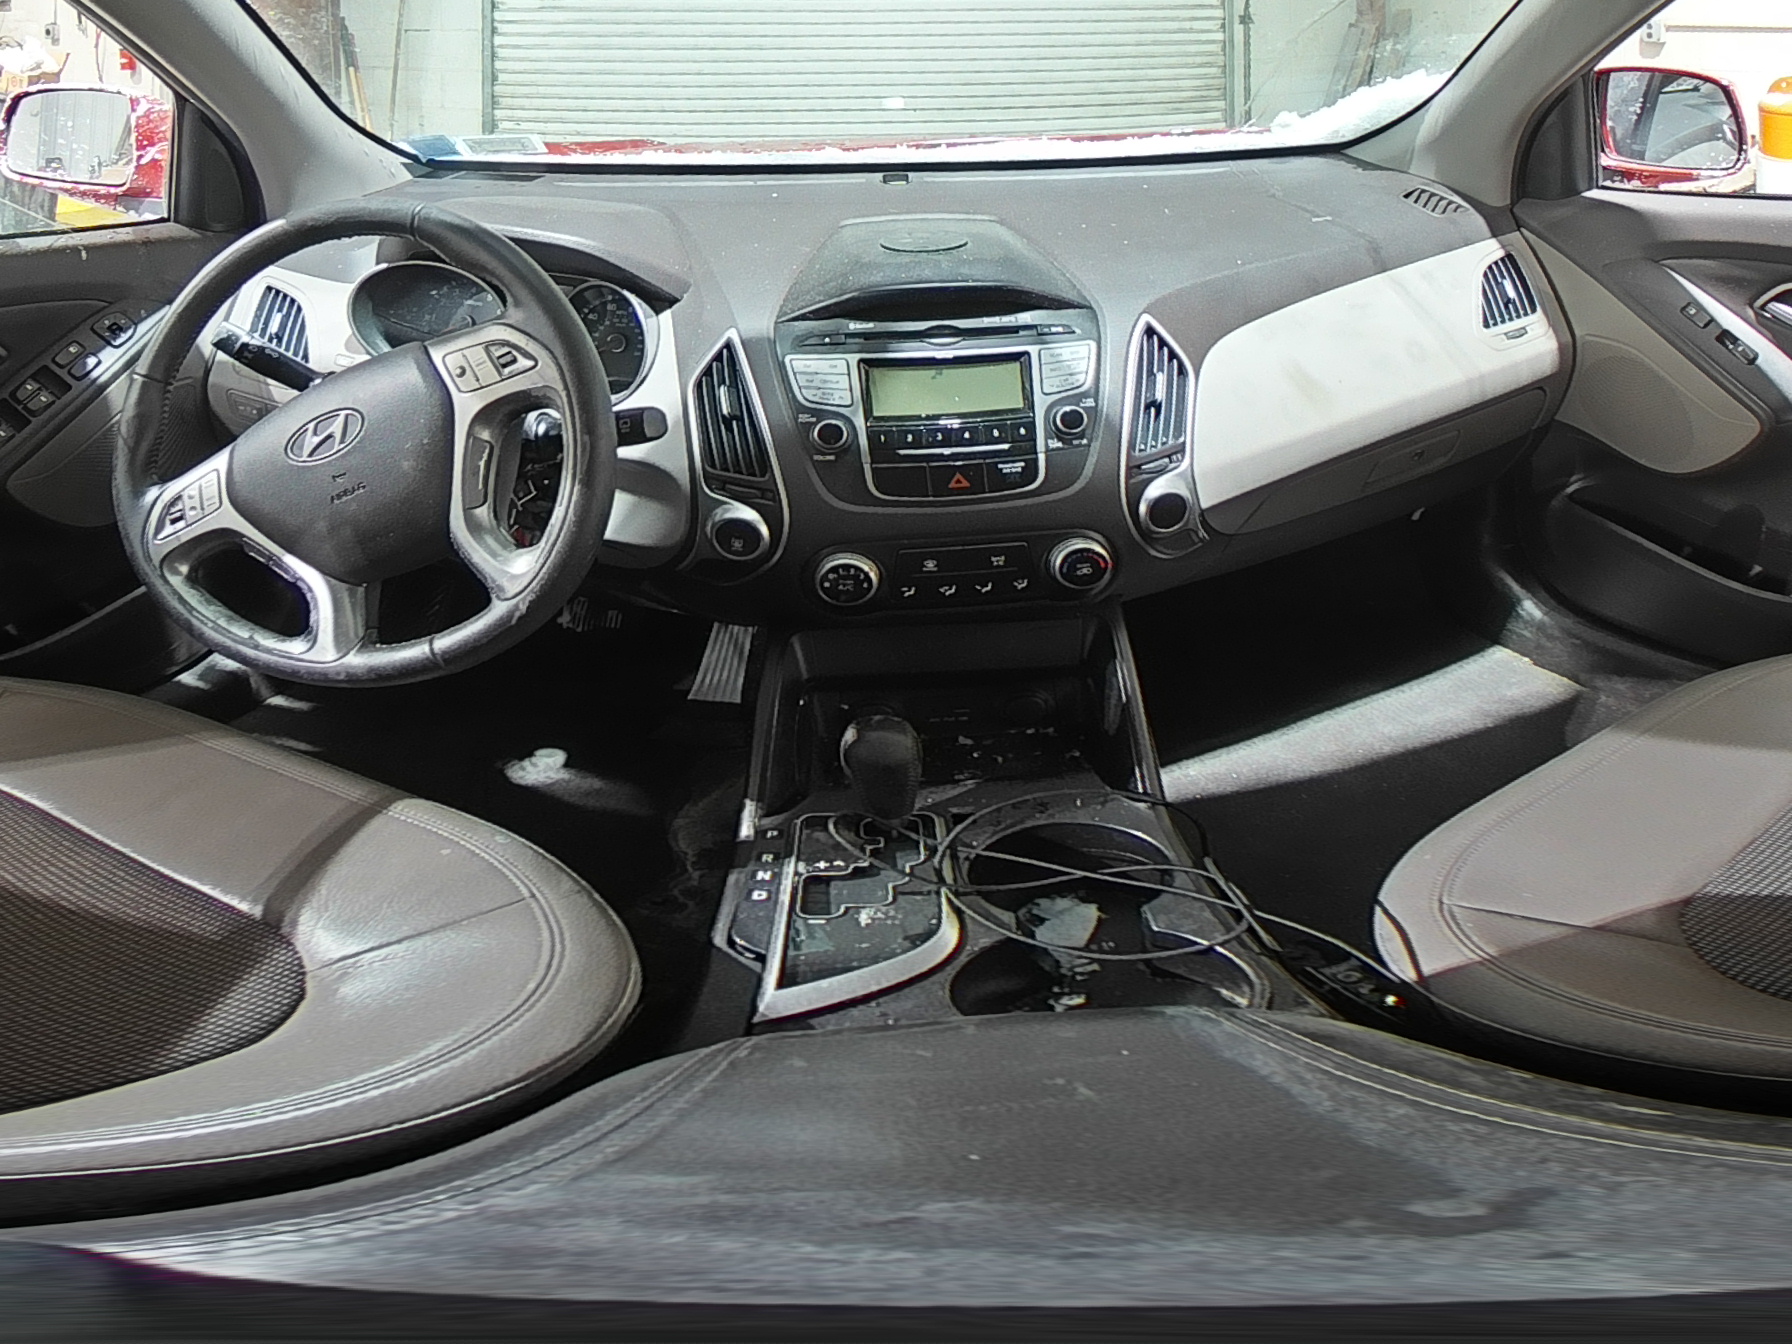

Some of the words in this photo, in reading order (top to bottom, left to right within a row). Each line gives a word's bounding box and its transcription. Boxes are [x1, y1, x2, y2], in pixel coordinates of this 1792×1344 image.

[766, 830, 779, 838] P
[762, 854, 774, 863] R
[756, 871, 773, 881] N
[751, 890, 769, 901] D
